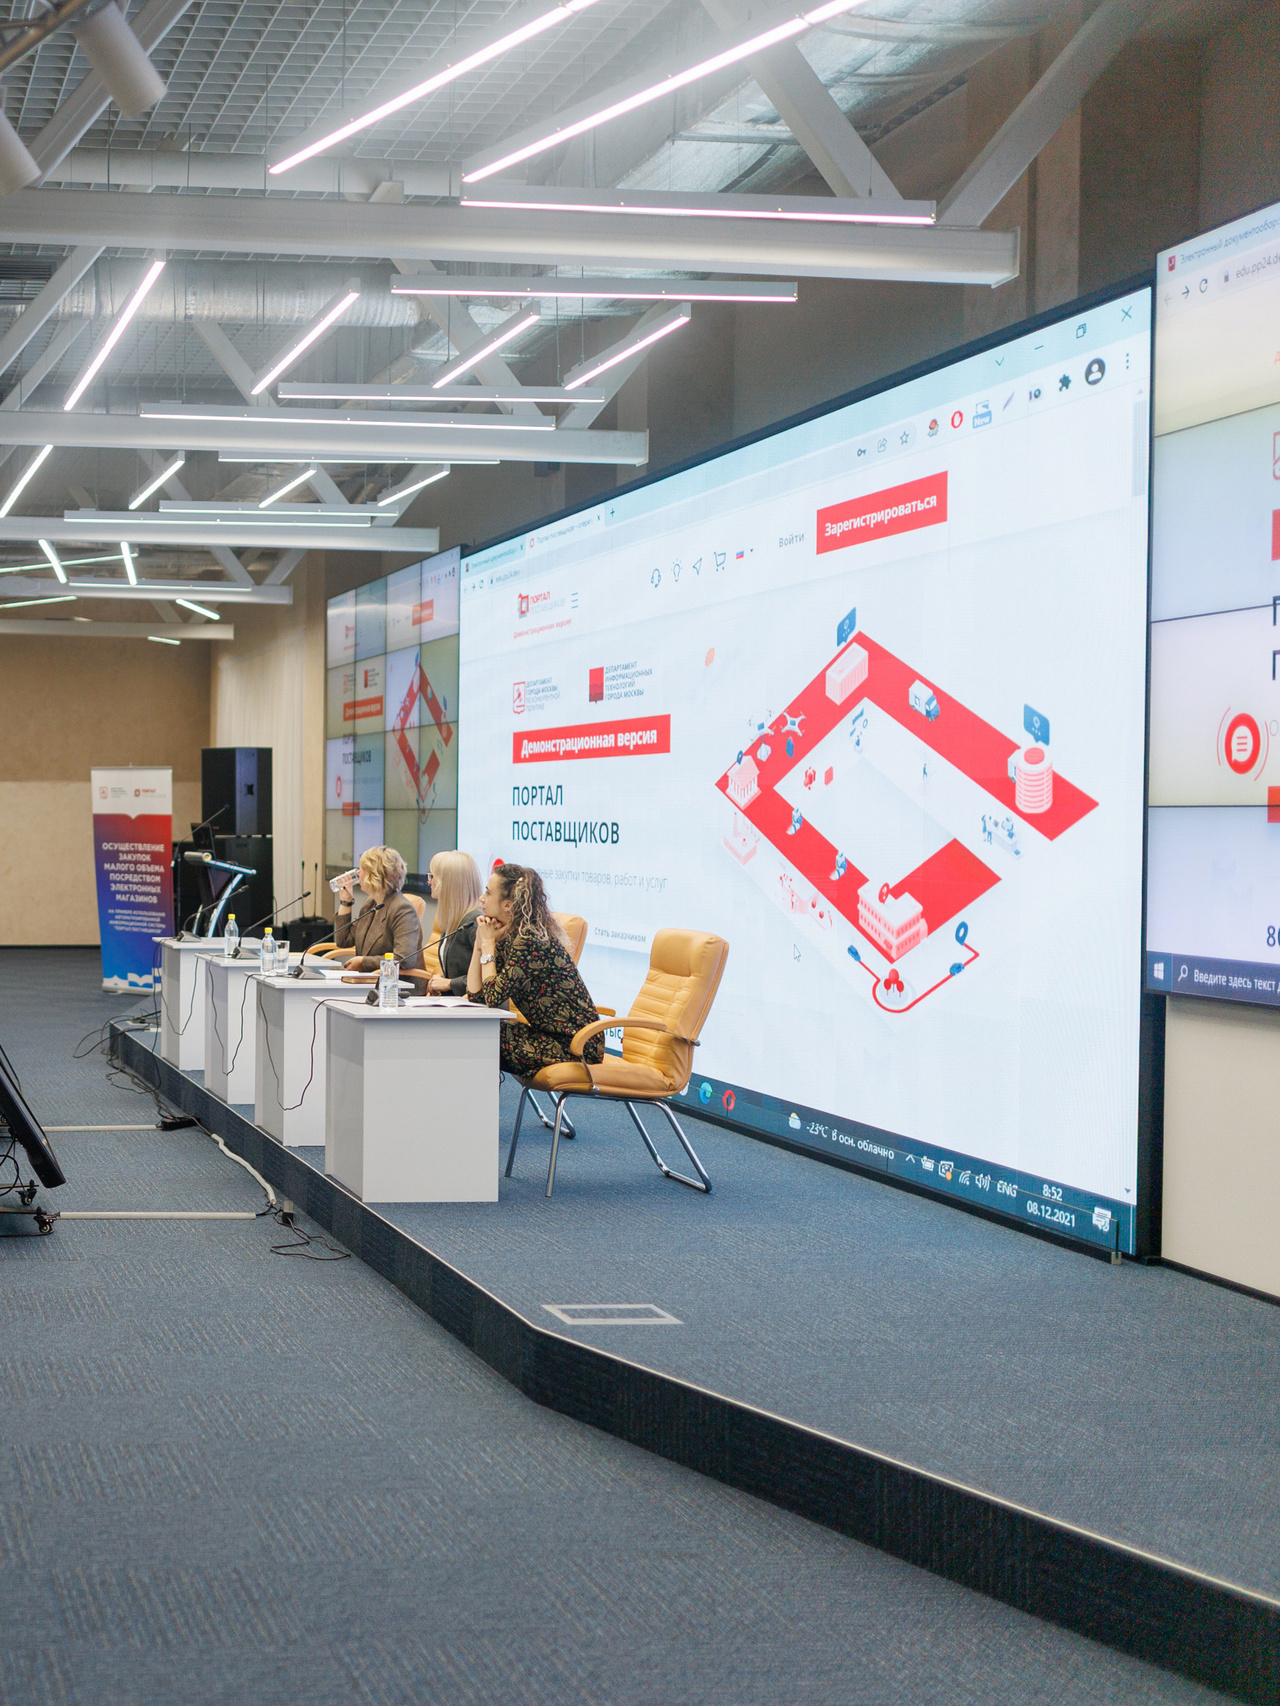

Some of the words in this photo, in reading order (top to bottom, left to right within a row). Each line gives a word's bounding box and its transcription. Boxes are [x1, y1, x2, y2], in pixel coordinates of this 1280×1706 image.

[778, 533, 805, 548] Войти
[824, 495, 938, 537] Зарегистрироваться
[530, 591, 551, 606] ПОРТАЛ
[605, 661, 637, 675] ДЕПАРТАМЕНТ
[605, 668, 653, 682] ИНФОРМАЦИОННЫХ
[605, 680, 636, 692] ТЕХНОЛОГИЙ
[605, 692, 622, 701] ГОРОДА
[623, 689, 645, 699] МОСКВЫ
[521, 734, 615, 759] Демонстрационная
[617, 730, 658, 750] версия
[512, 785, 563, 806] ПОРТАЛ
[512, 821, 620, 848] ПОСТАВЩИКОВ
[102, 842, 165, 852] ОСУЩЕСТВЛЕНИЕ
[119, 853, 152, 862] ЗАКУПОК
[104, 863, 135, 871] МАЛОГО
[136, 864, 165, 873] ОБЪЕМА
[109, 873, 161, 883] ПОСРЕДСТВОМ
[555, 869, 581, 884] закупки
[581, 871, 612, 886] товаров,
[614, 872, 637, 888] работ
[646, 877, 667, 893] услуг
[110, 883, 161, 893] ЭЛЕКТРОННЫХ
[115, 894, 158, 904] МАГАЗИНОВ
[594, 927, 610, 938] Стать
[611, 931, 647, 943] заказчиком
[1194, 969, 1227, 986] Введите
[1228, 976, 1252, 989] здесь
[1253, 979, 1276, 991] текст
[839, 1134, 856, 1147] осн.
[857, 1139, 895, 1160] облачно
[997, 1180, 1019, 1198] ENG
[1042, 1184, 1063, 1201] 8:52
[1027, 1200, 1076, 1228] 08.12.2021
